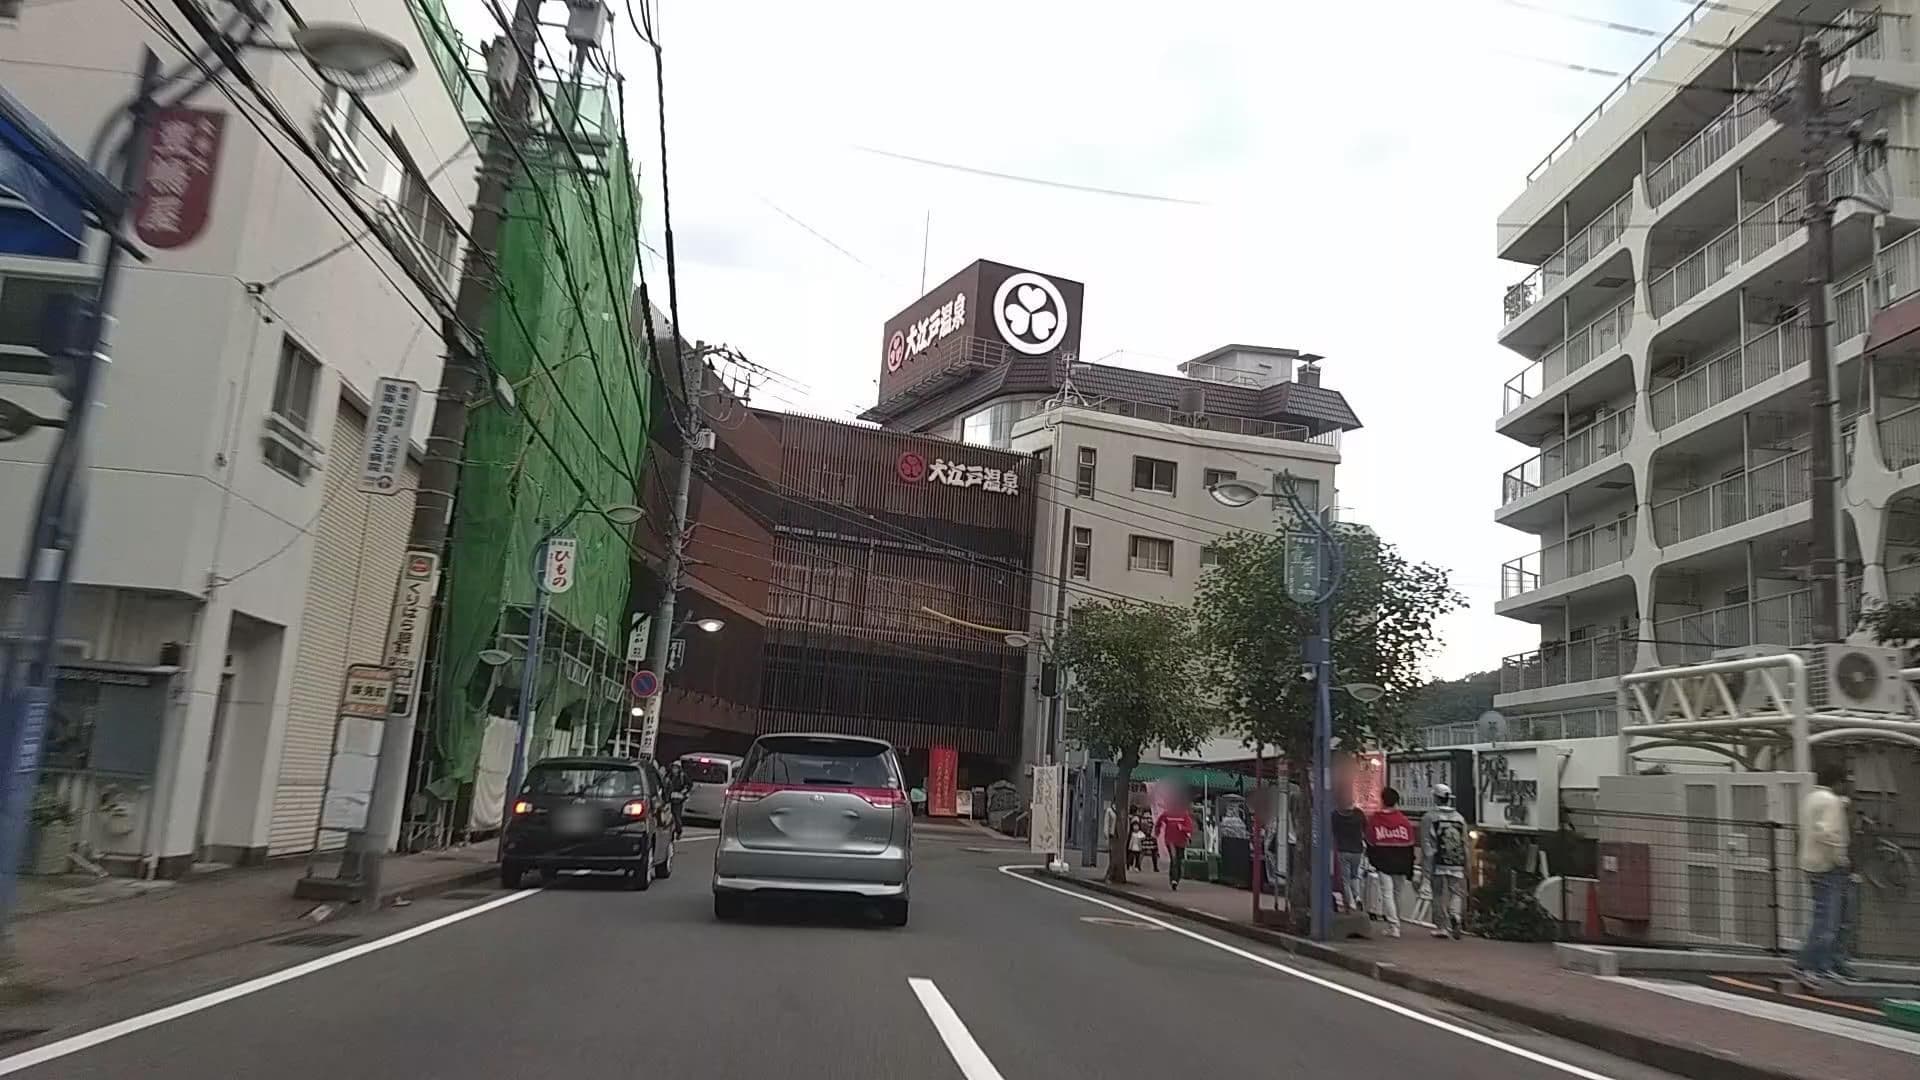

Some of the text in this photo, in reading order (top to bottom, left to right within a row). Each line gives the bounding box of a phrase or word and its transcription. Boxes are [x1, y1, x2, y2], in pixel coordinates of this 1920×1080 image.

[904, 293, 966, 360] 大江戸温泉
[928, 458, 1019, 496] 大江戸温泉
[552, 550, 571, 587] ひもの
